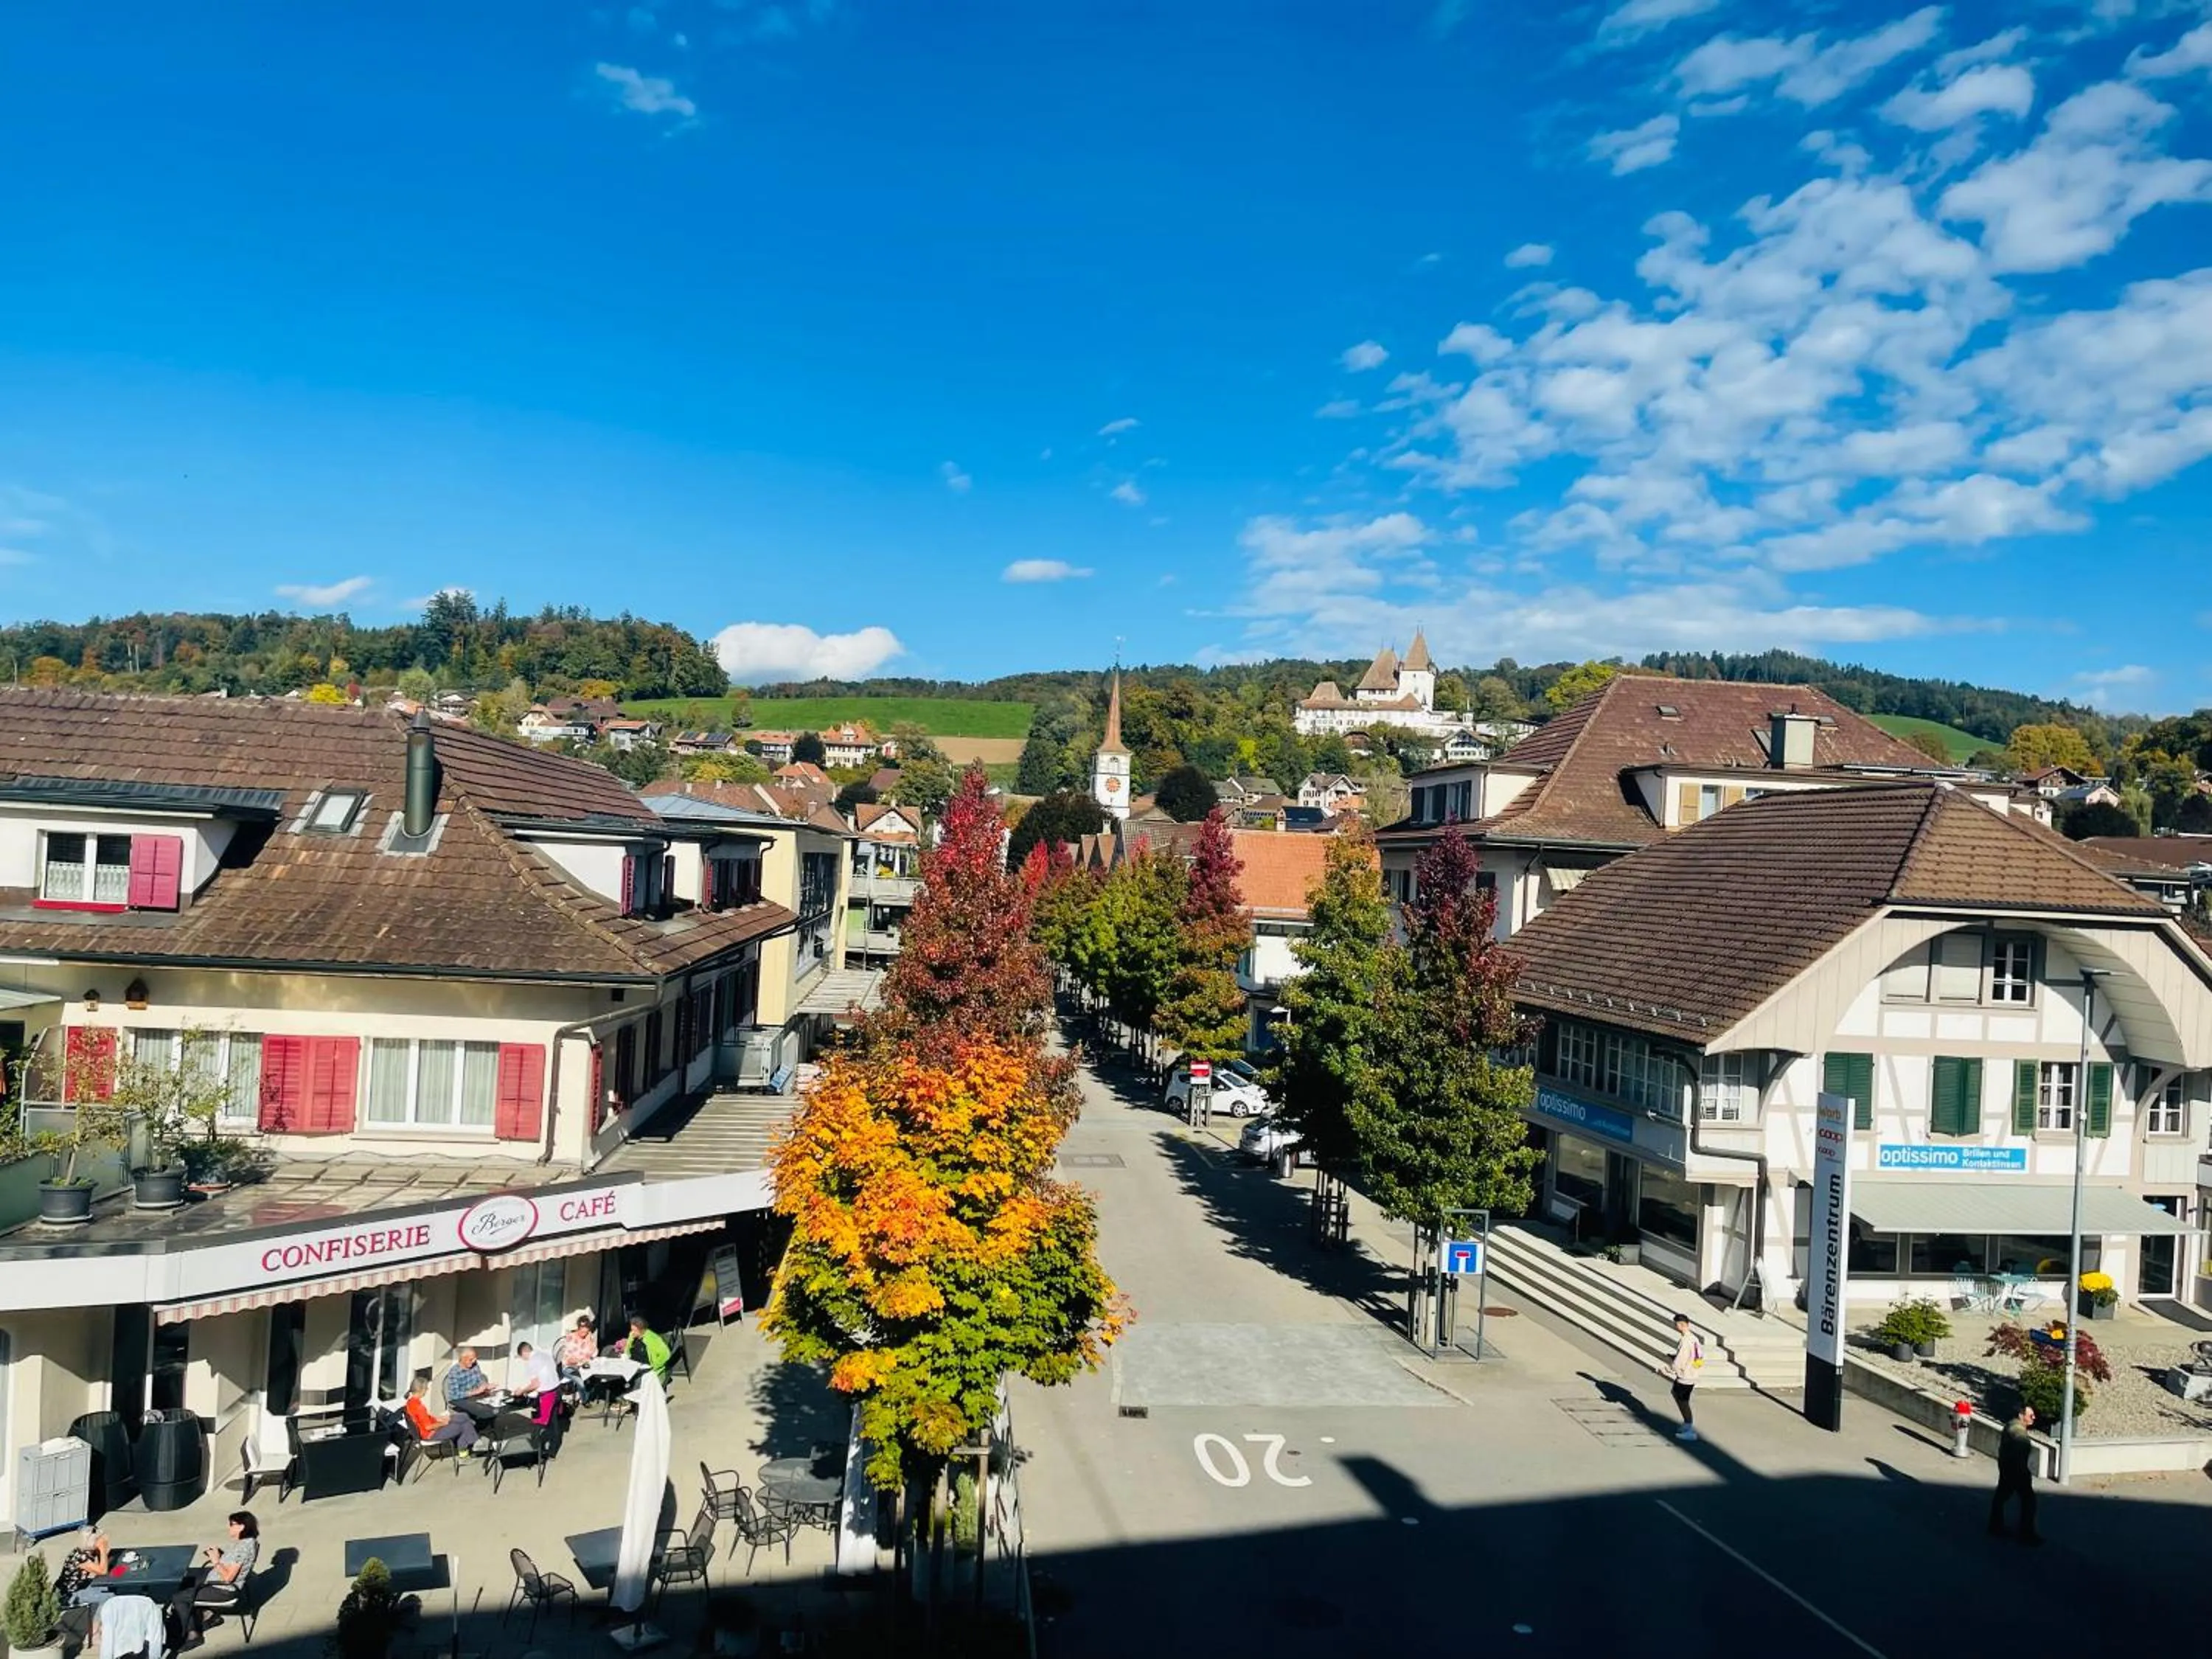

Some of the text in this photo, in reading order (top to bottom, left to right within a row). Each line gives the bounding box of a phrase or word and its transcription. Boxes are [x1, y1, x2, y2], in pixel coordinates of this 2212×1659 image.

[1540, 1093, 1586, 1121] optissimo
[1819, 1128, 1843, 1144] coop
[1881, 1147, 1958, 1166] optissimo
[1962, 1148, 2011, 1158] Brillen und
[1962, 1159, 2022, 1169] Kontaktlinsen
[560, 1191, 616, 1222] CAFÉ
[261, 1225, 431, 1272] CONFISERIE
[1820, 1173, 1841, 1336] Bärenzentrum
[1194, 1433, 1312, 1487] 20
